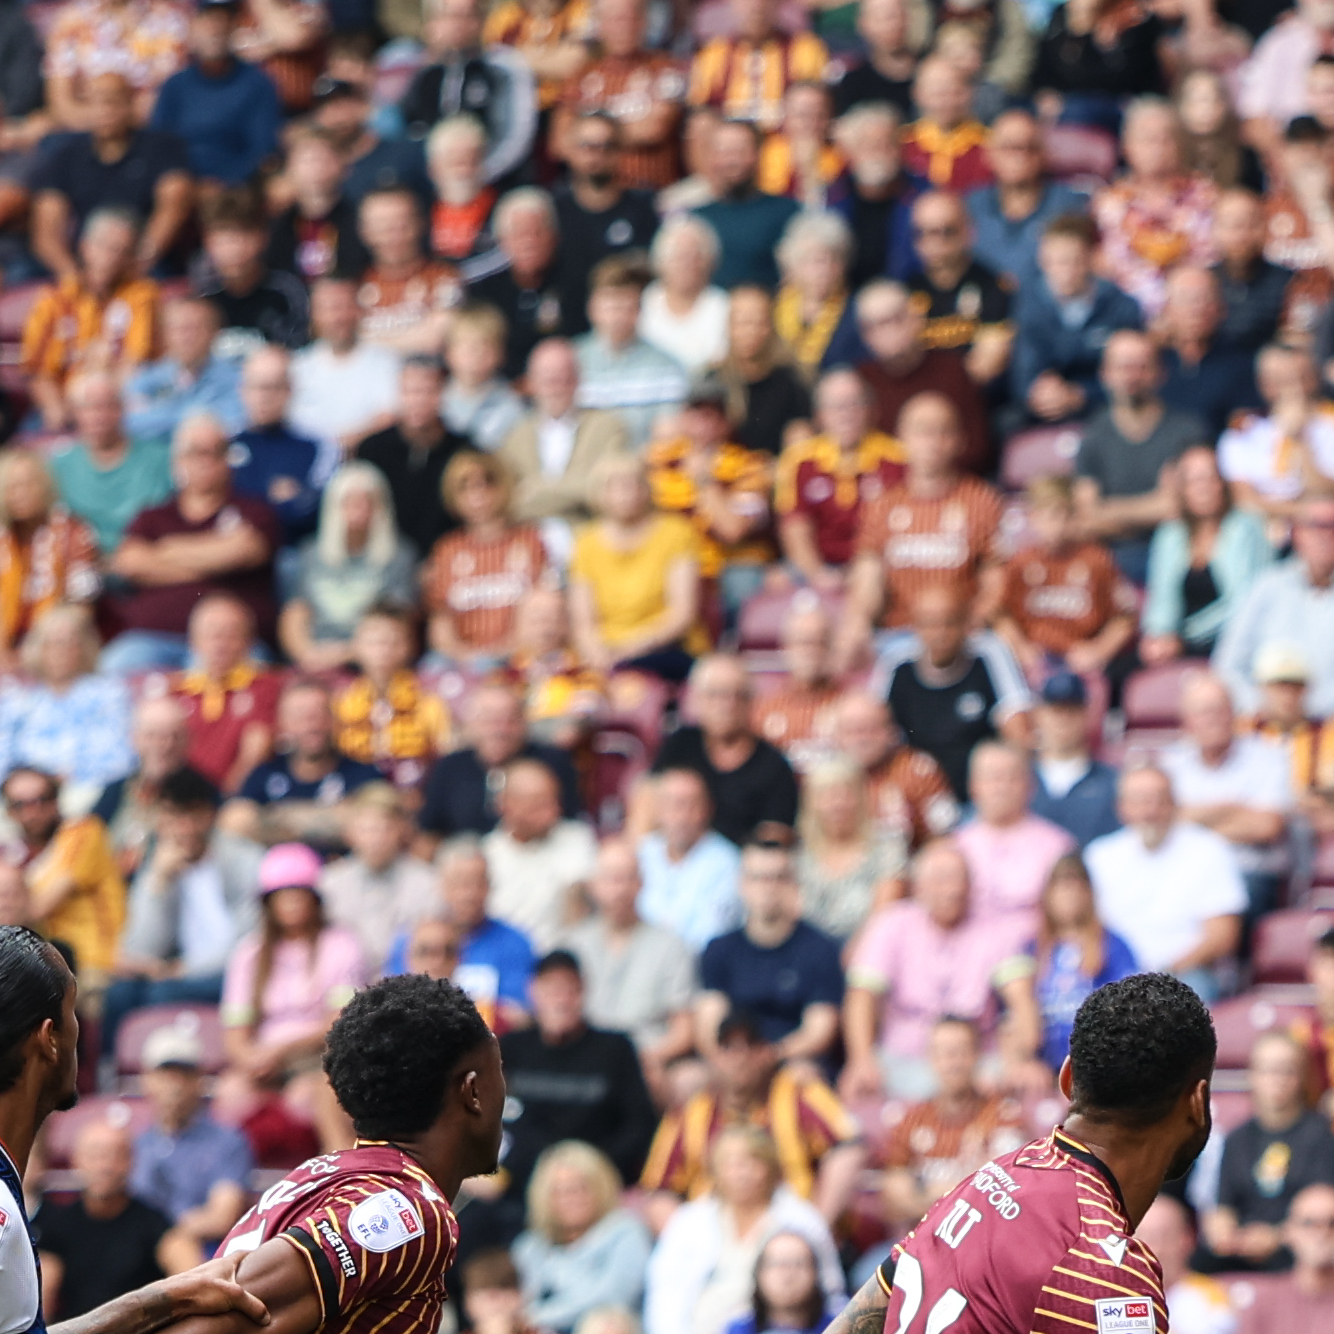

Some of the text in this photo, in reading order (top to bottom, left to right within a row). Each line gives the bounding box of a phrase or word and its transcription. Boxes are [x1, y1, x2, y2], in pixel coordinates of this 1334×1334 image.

[1102, 1305, 1147, 1318] sky bet
[1105, 1319, 1149, 1329] LEAGUE ONE
